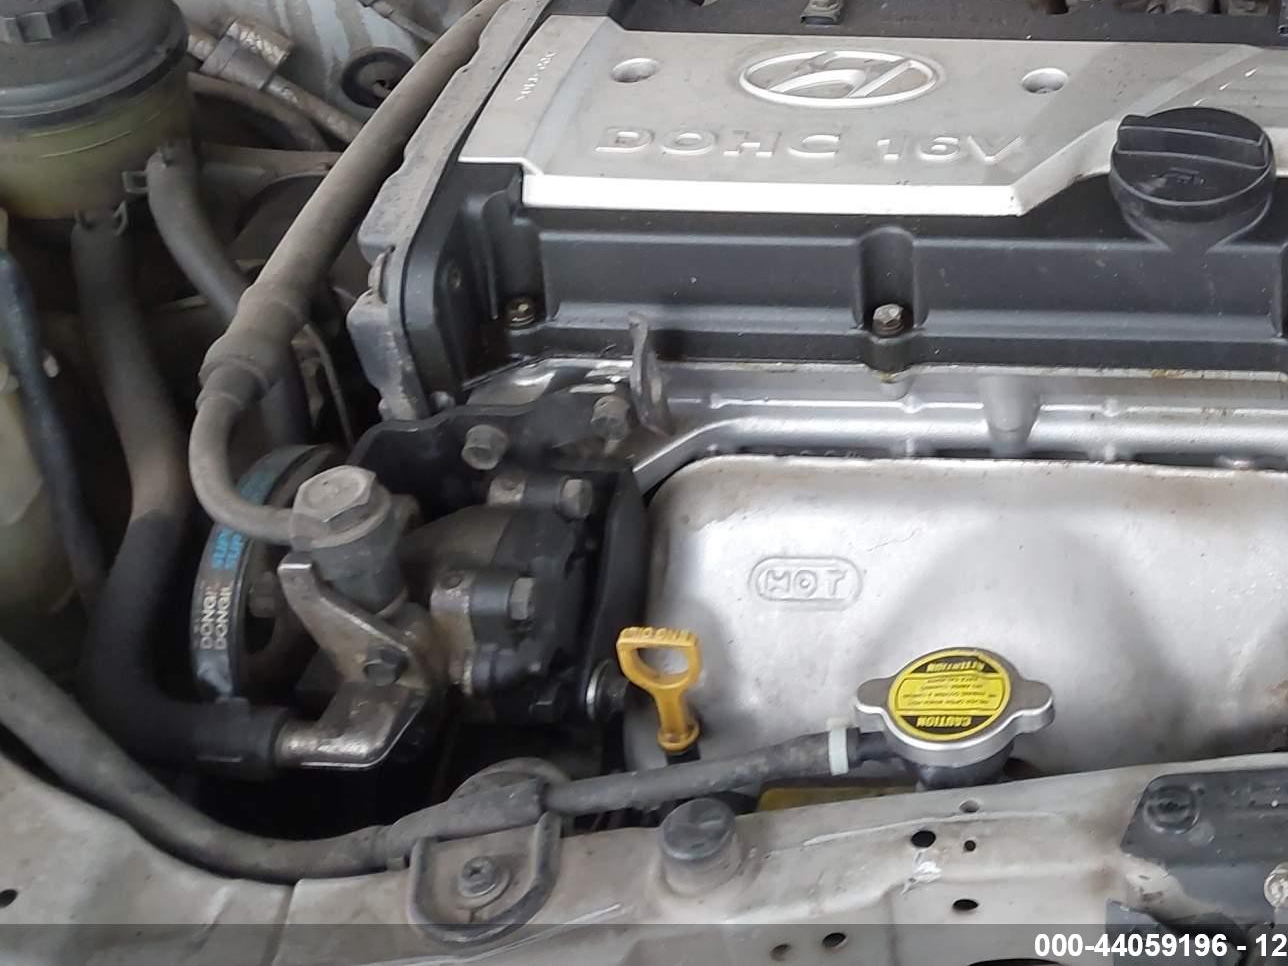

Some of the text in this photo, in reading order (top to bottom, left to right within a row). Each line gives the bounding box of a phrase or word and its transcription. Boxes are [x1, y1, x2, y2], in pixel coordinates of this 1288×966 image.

[595, 127, 1023, 164] DOHC 16V
[764, 568, 847, 598] HOT
[916, 715, 973, 728] CAUTION
